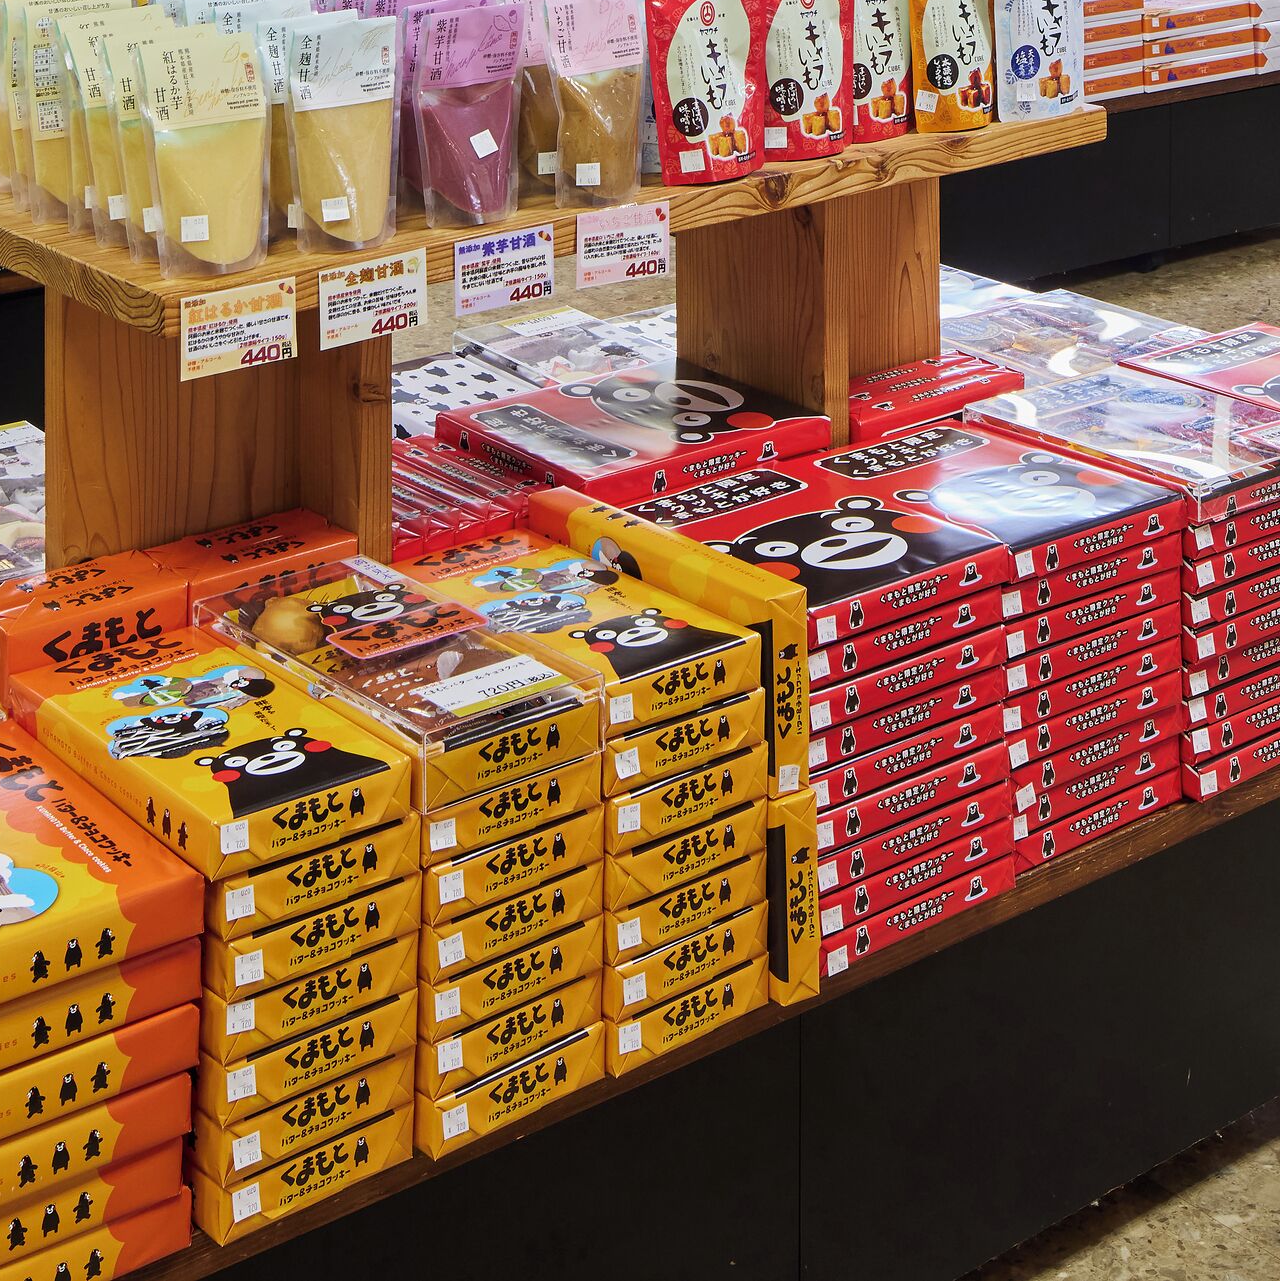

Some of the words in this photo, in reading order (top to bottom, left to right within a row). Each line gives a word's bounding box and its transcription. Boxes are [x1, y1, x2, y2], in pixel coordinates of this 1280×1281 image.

[554, 6, 571, 68] いちご甘酒
[699, 27, 718, 36] ヤマウチ
[430, 19, 447, 81] 紫芋甘酒
[1056, 46, 1067, 54] CUBE
[162, 50, 184, 111] 紅はるか芋
[297, 35, 313, 101] 全麹甘酒
[887, 65, 901, 73] CUBE
[154, 87, 170, 121] 甘酒
[482, 233, 536, 257] 紫芋甘酒
[345, 261, 404, 287] 全麹甘酒
[188, 293, 283, 324] 紅はるか甘酒
[834, 430, 944, 465] くまもと限定
[852, 437, 974, 477] くまもとが好き
[863, 443, 935, 466] クッキー
[412, 535, 521, 568] くまもと
[1073, 523, 1134, 549] くまもと限定クッキー
[1083, 536, 1124, 555] くまもとが好き
[880, 573, 949, 604] くまもと限定クッキー
[892, 587, 938, 609] くまもとが好き
[43, 607, 163, 662] くまもと
[338, 602, 460, 644] くまもと
[76, 675, 116, 690] KUMAMOTO
[477, 680, 522, 699] 720円
[651, 662, 709, 695] くまもと
[777, 666, 791, 740] くまもと
[271, 791, 344, 832] くまもと
[886, 891, 954, 927] くまもと限定クッキー
[898, 905, 943, 931] くまもとが好き
[488, 1062, 549, 1105] くまもと
